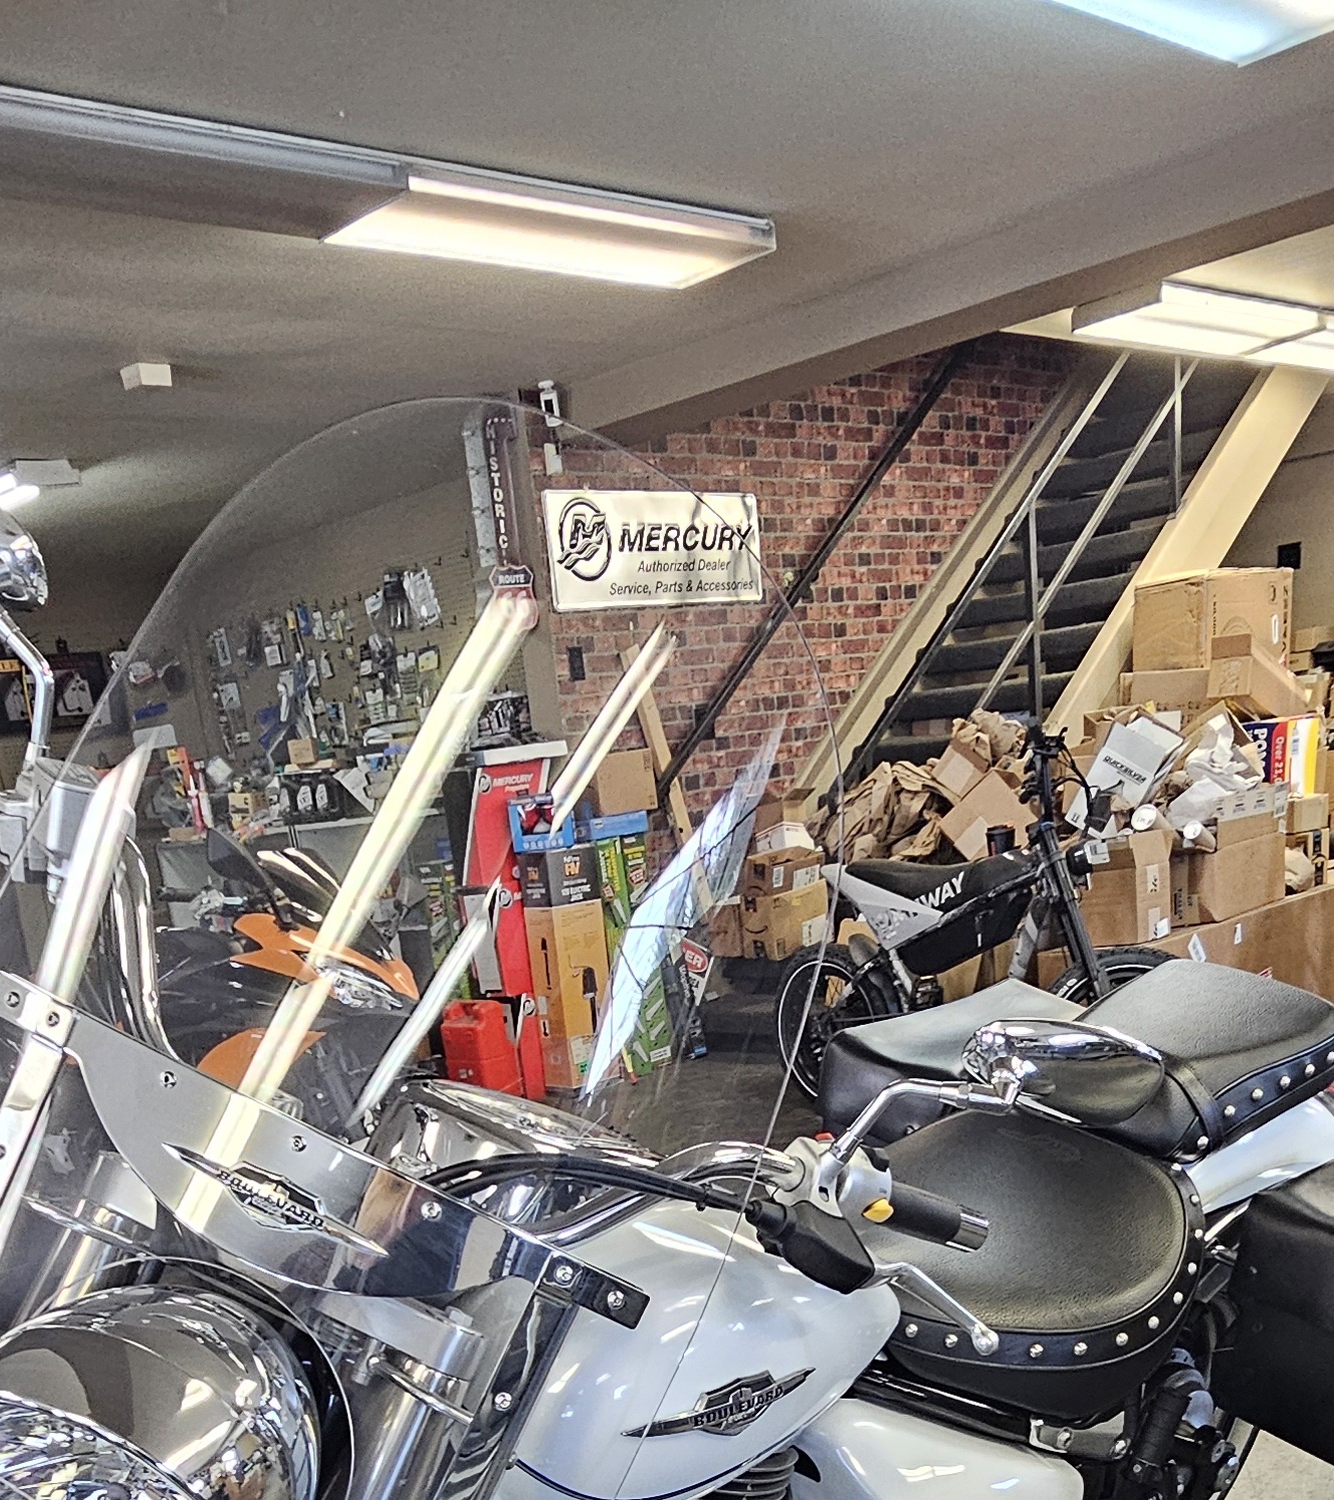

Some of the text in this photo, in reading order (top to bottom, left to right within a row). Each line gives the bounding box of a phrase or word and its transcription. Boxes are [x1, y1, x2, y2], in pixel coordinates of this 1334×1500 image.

[487, 423, 508, 549] HISTORIC
[619, 523, 753, 552] MERCURY
[637, 558, 731, 573] Authorized Dealer
[499, 574, 525, 584] ROUTE
[609, 577, 754, 595] Service, Parts & Accessories
[1275, 736, 1285, 760] Over
[493, 773, 534, 786] MERCURY
[914, 871, 965, 908] WAY
[693, 1385, 784, 1427] BOULEVARD
